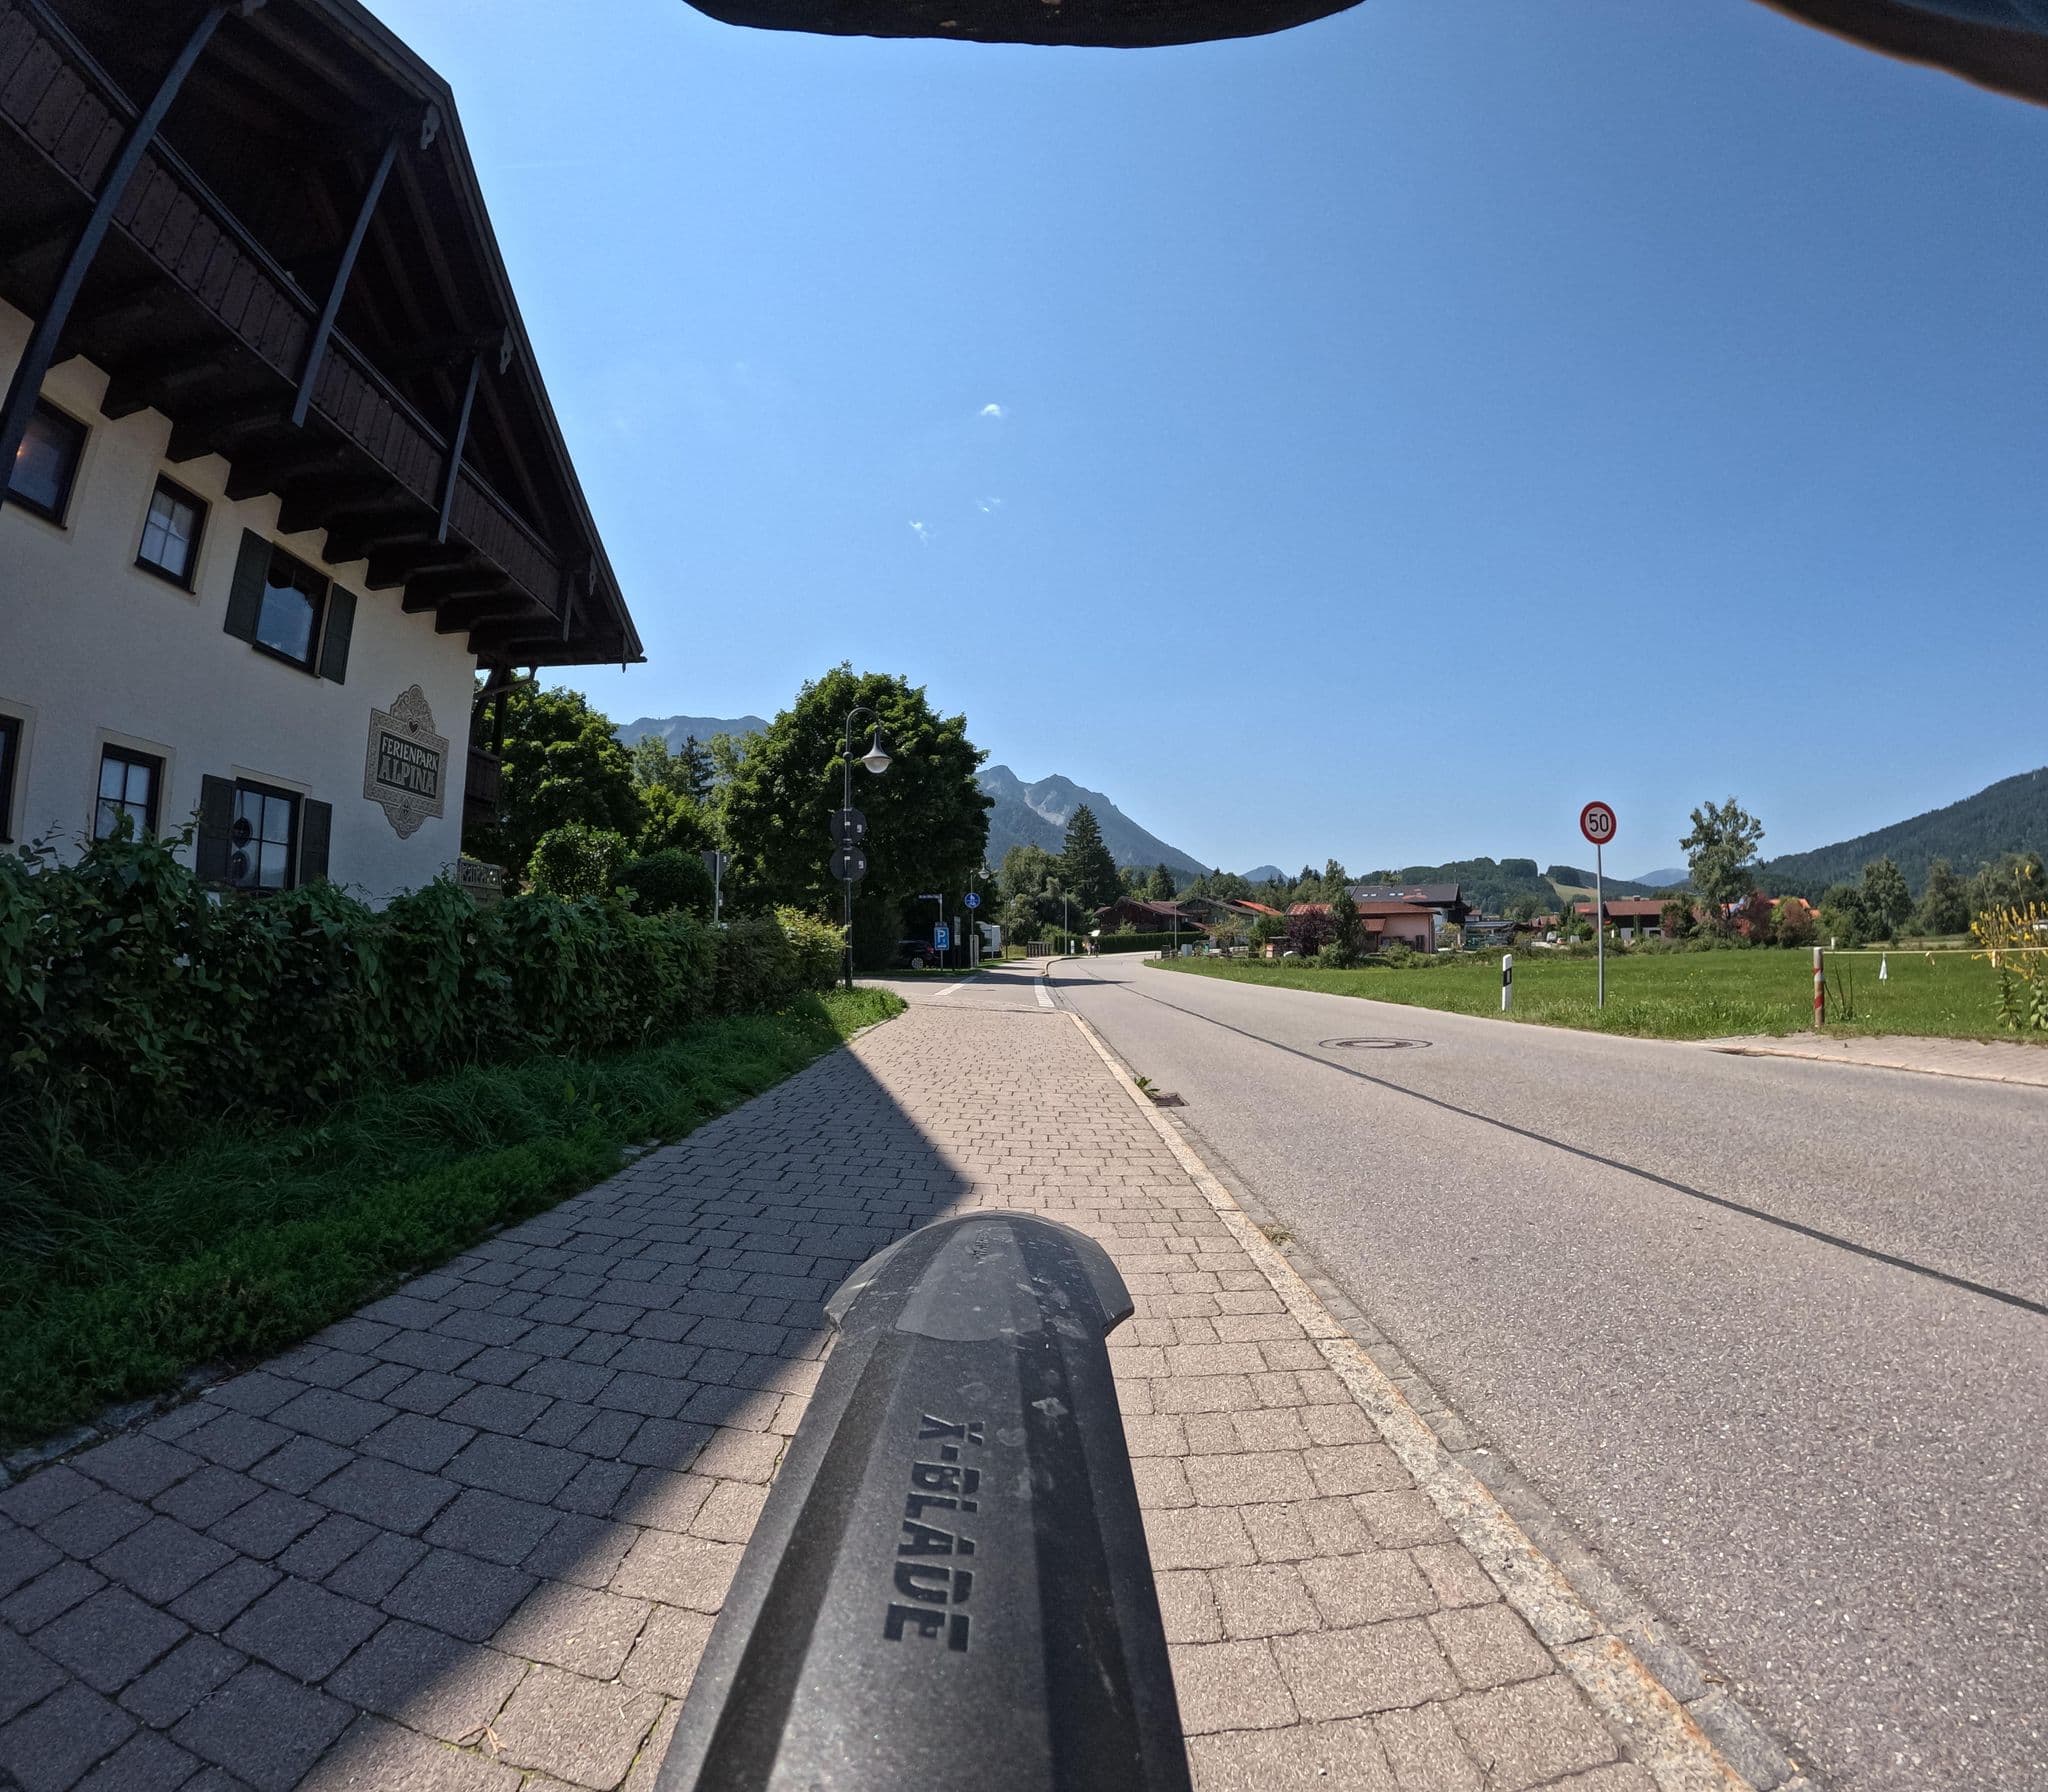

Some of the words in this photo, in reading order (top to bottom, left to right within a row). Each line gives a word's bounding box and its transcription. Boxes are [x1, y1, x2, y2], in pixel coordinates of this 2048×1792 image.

[381, 736, 440, 772] FERIENPARK
[378, 756, 437, 796] ALPINA
[1589, 814, 1609, 832] 50
[938, 930, 946, 943] P
[883, 1413, 985, 1653] X-BLADE
